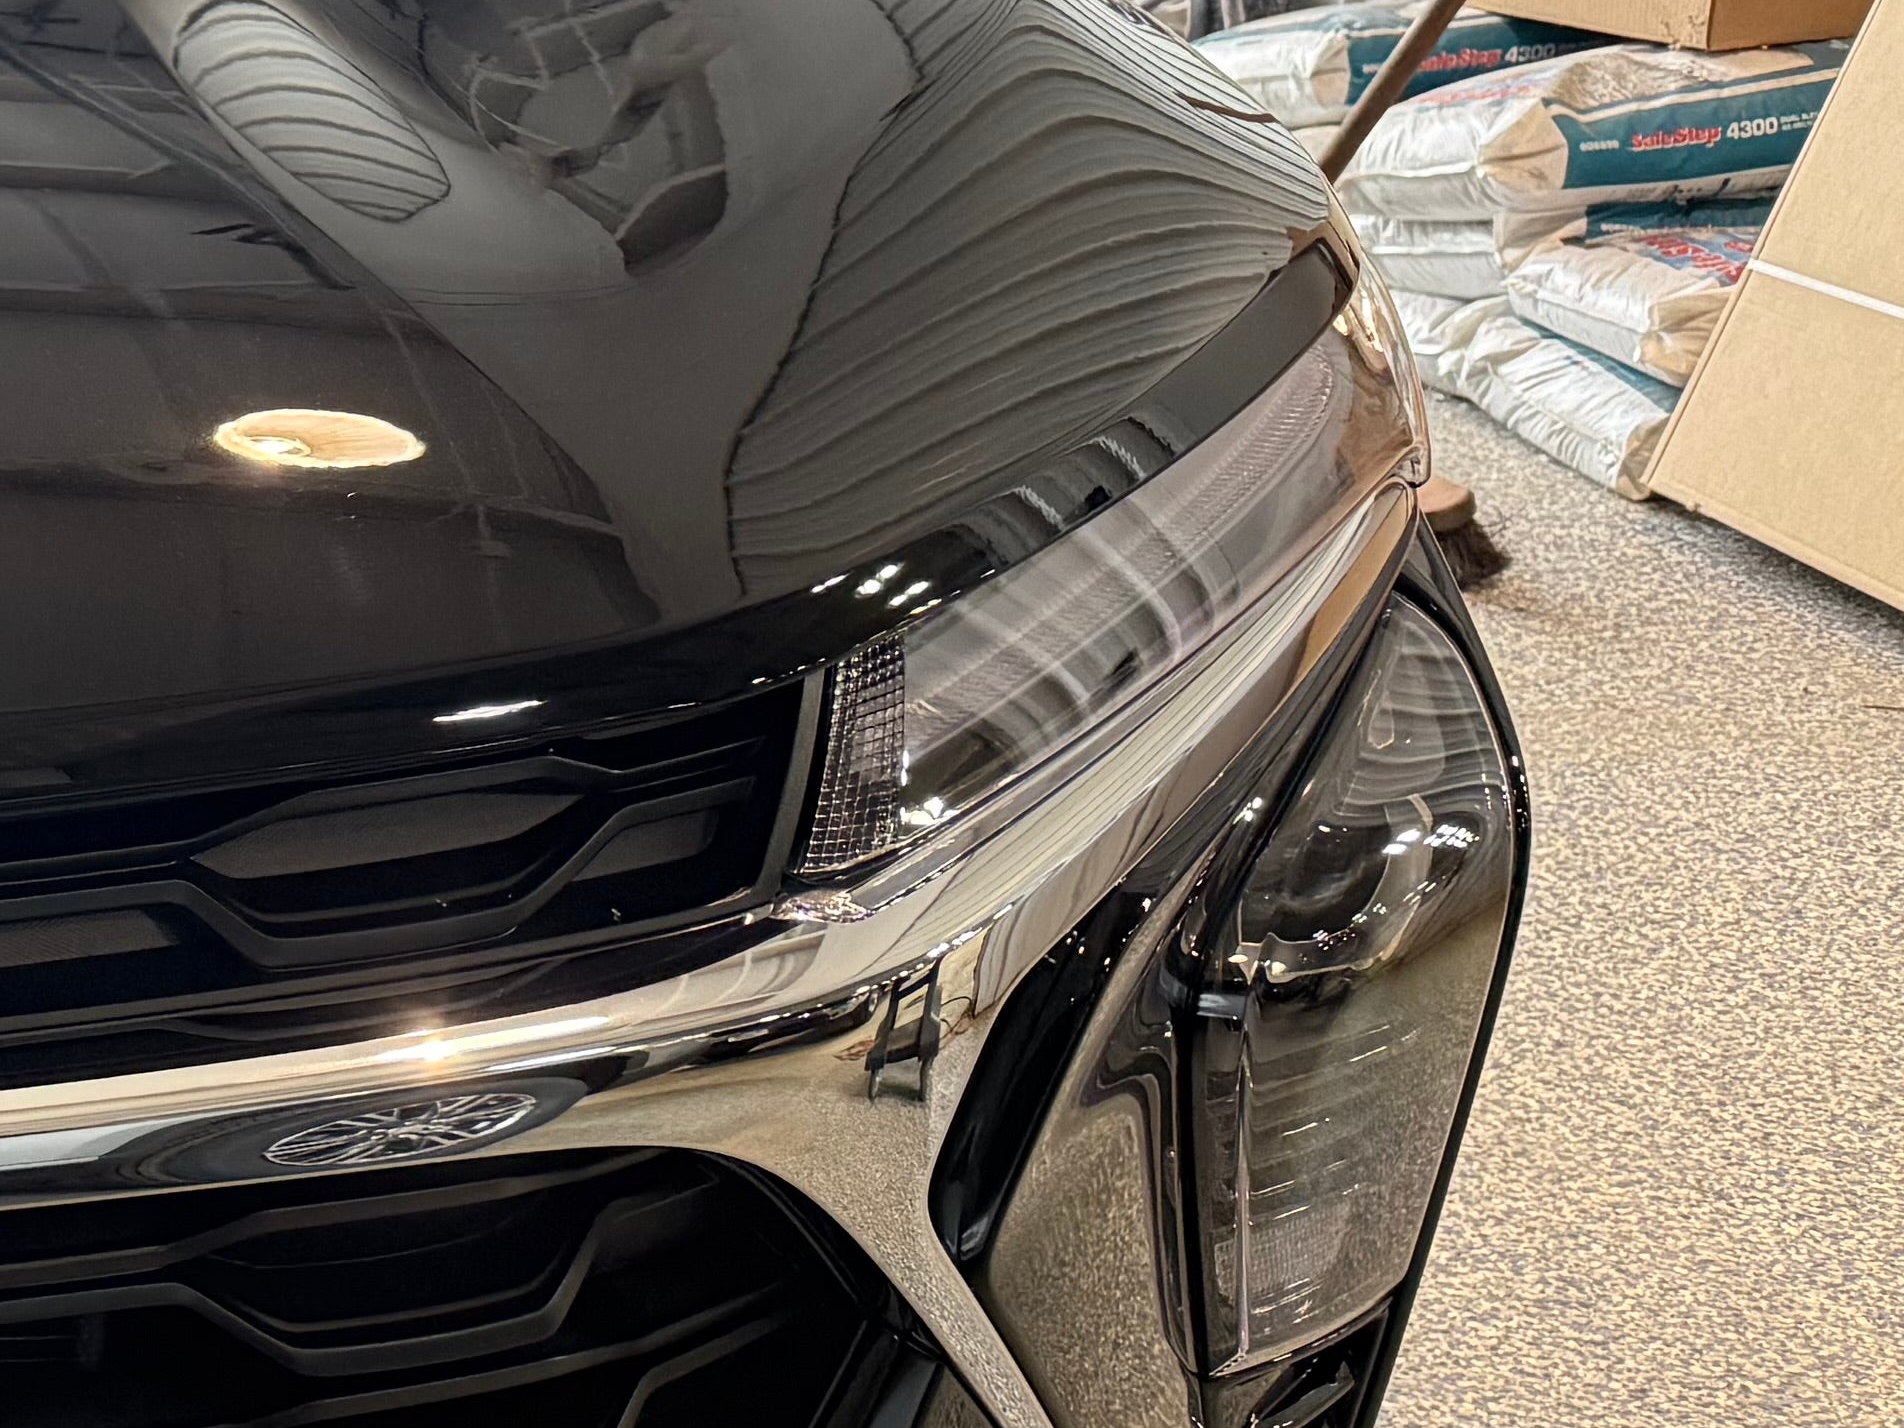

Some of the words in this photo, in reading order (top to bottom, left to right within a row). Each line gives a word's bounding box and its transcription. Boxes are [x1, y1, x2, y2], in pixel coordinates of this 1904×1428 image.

[1504, 42, 1556, 64] 4300
[1630, 126, 1723, 152] SafeStep
[1726, 116, 1779, 141] 4300
